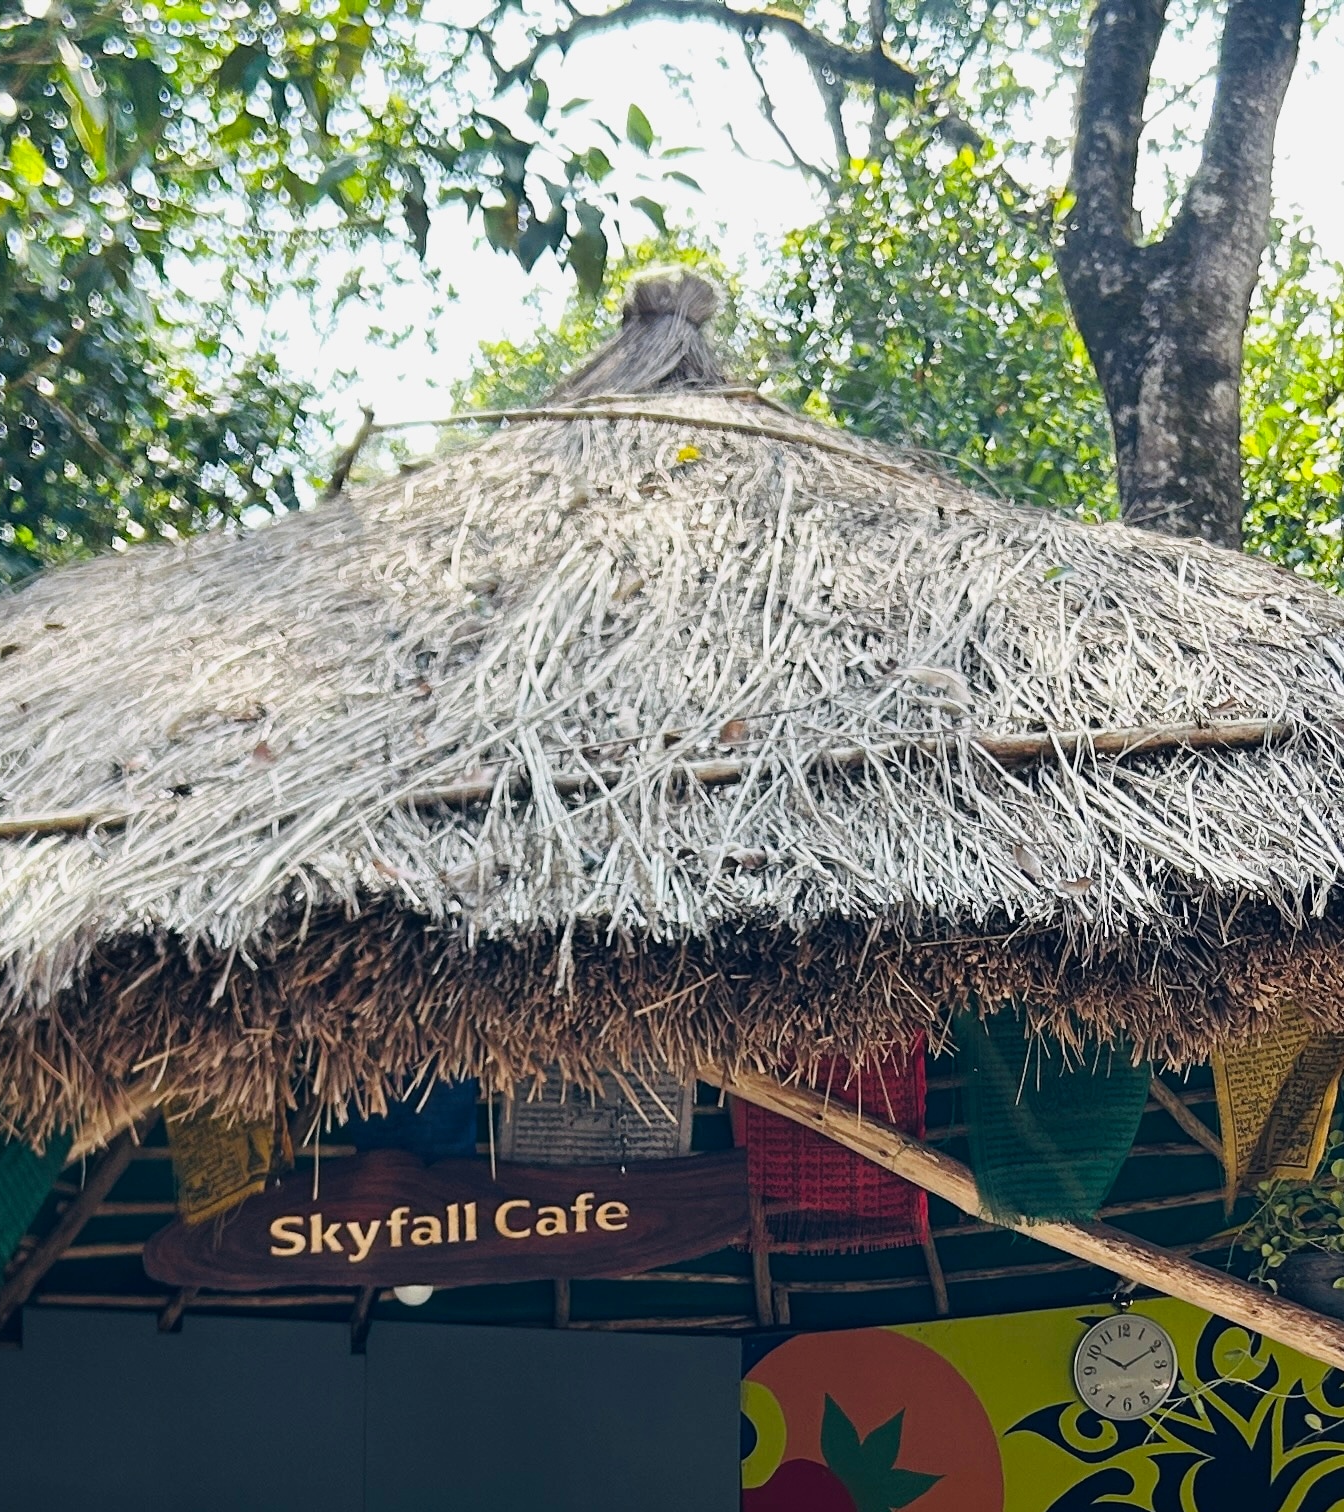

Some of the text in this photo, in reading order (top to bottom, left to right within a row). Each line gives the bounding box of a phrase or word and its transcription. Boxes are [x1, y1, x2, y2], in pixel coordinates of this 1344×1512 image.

[270, 1192, 630, 1262] Skyfall Cafe
[1099, 1330, 1113, 1345] 11
[1118, 1323, 1131, 1338] 12
[1138, 1328, 1145, 1340] 1
[1087, 1345, 1102, 1361] 10
[1150, 1339, 1162, 1353] 2
[1083, 1366, 1097, 1376] 9
[1154, 1360, 1167, 1369] 3
[1089, 1383, 1102, 1396] 8
[1105, 1394, 1116, 1408] 7
[1123, 1397, 1132, 1412] 6
[1139, 1391, 1150, 1405] 5
